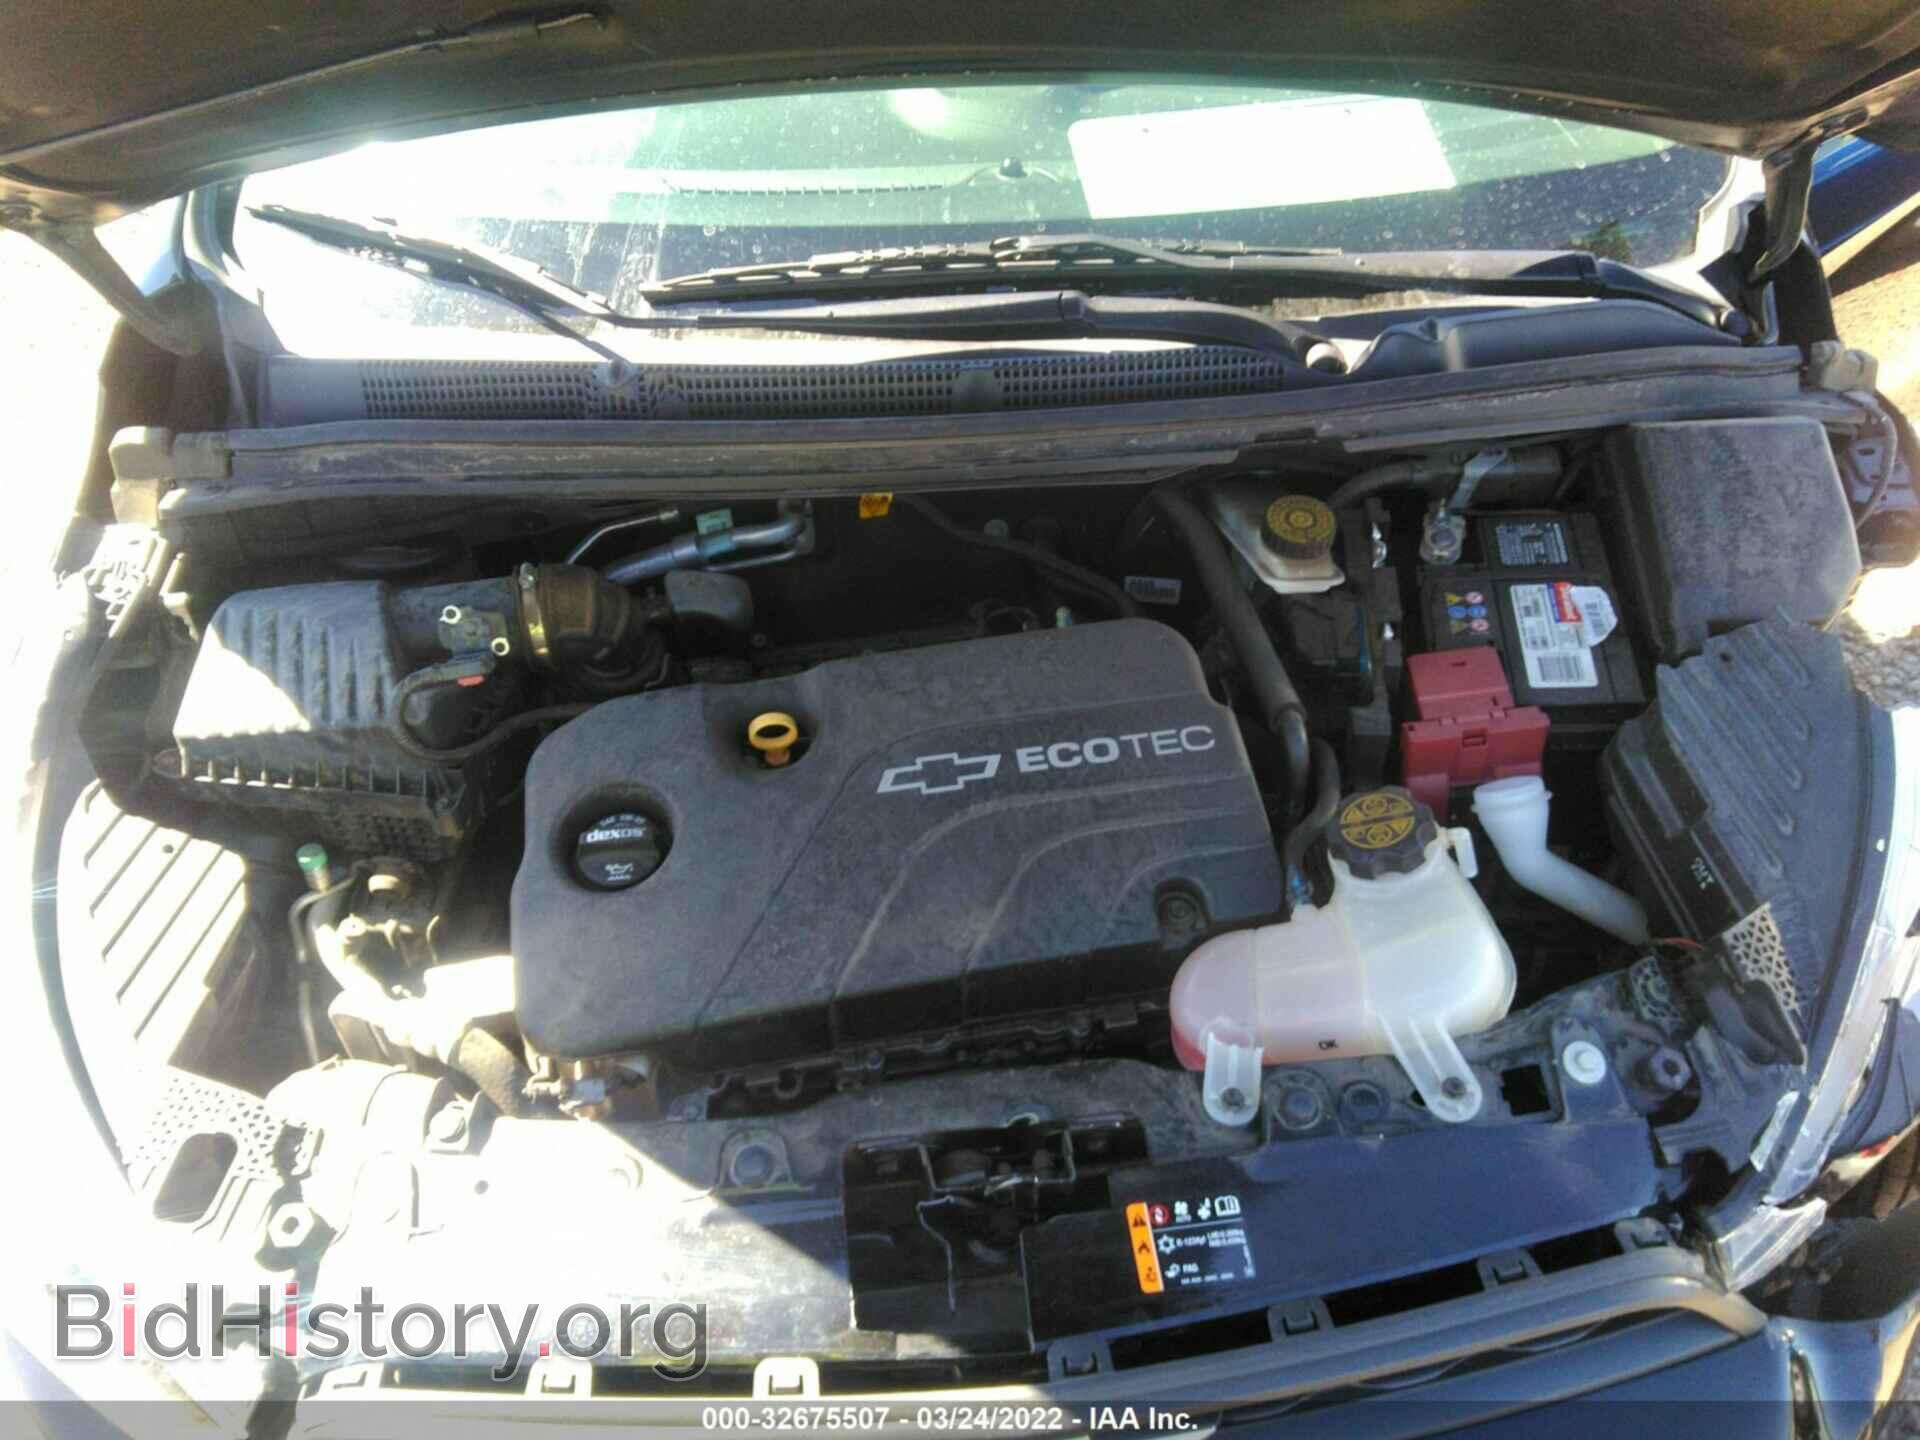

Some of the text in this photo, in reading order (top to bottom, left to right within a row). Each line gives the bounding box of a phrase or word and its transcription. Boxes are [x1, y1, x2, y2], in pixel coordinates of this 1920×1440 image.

[1015, 724, 1216, 773] ECOTEC
[586, 829, 643, 843] dexos
[1318, 1038, 1338, 1050] OK
